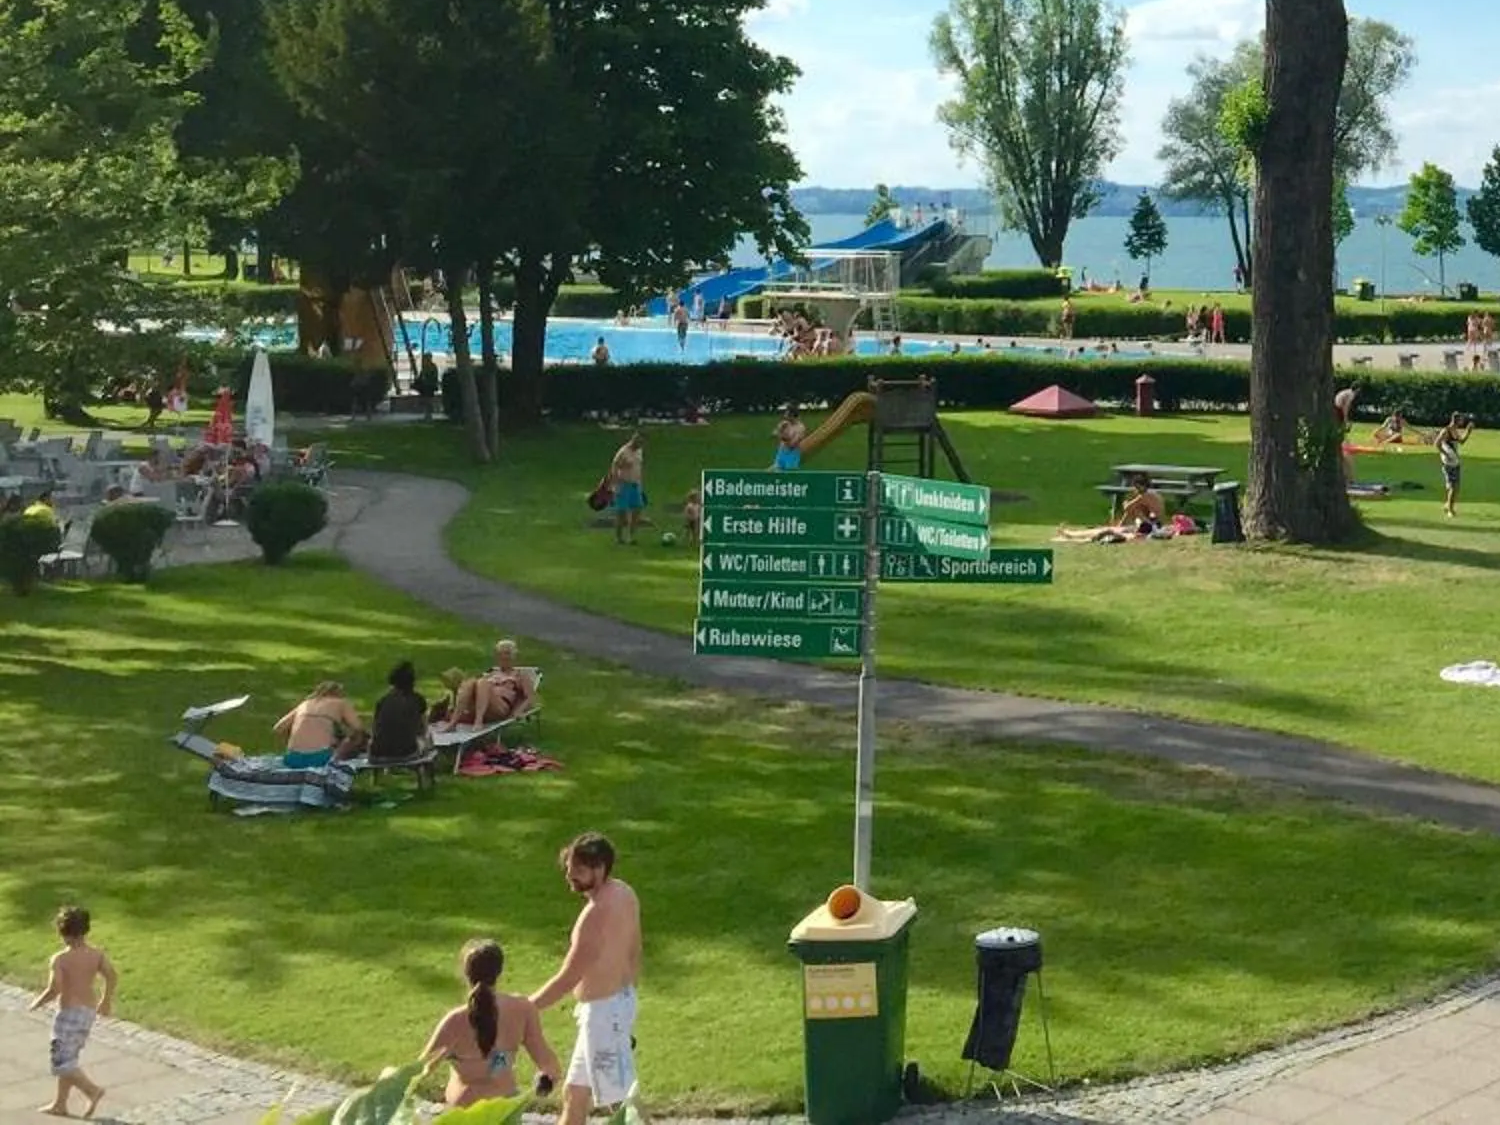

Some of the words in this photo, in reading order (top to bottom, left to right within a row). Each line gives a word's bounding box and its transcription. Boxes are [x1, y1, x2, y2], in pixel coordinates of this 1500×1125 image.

[715, 478, 808, 497] Bademeister
[722, 516, 763, 534] Erste
[767, 516, 807, 535] Hilfe
[917, 525, 979, 551] WC/Toiletten
[719, 554, 806, 573] WC/Toiletten
[941, 557, 1037, 577] Sportbereich
[713, 589, 804, 610] Mutter/Kind
[709, 628, 802, 648] Ruhewiese
